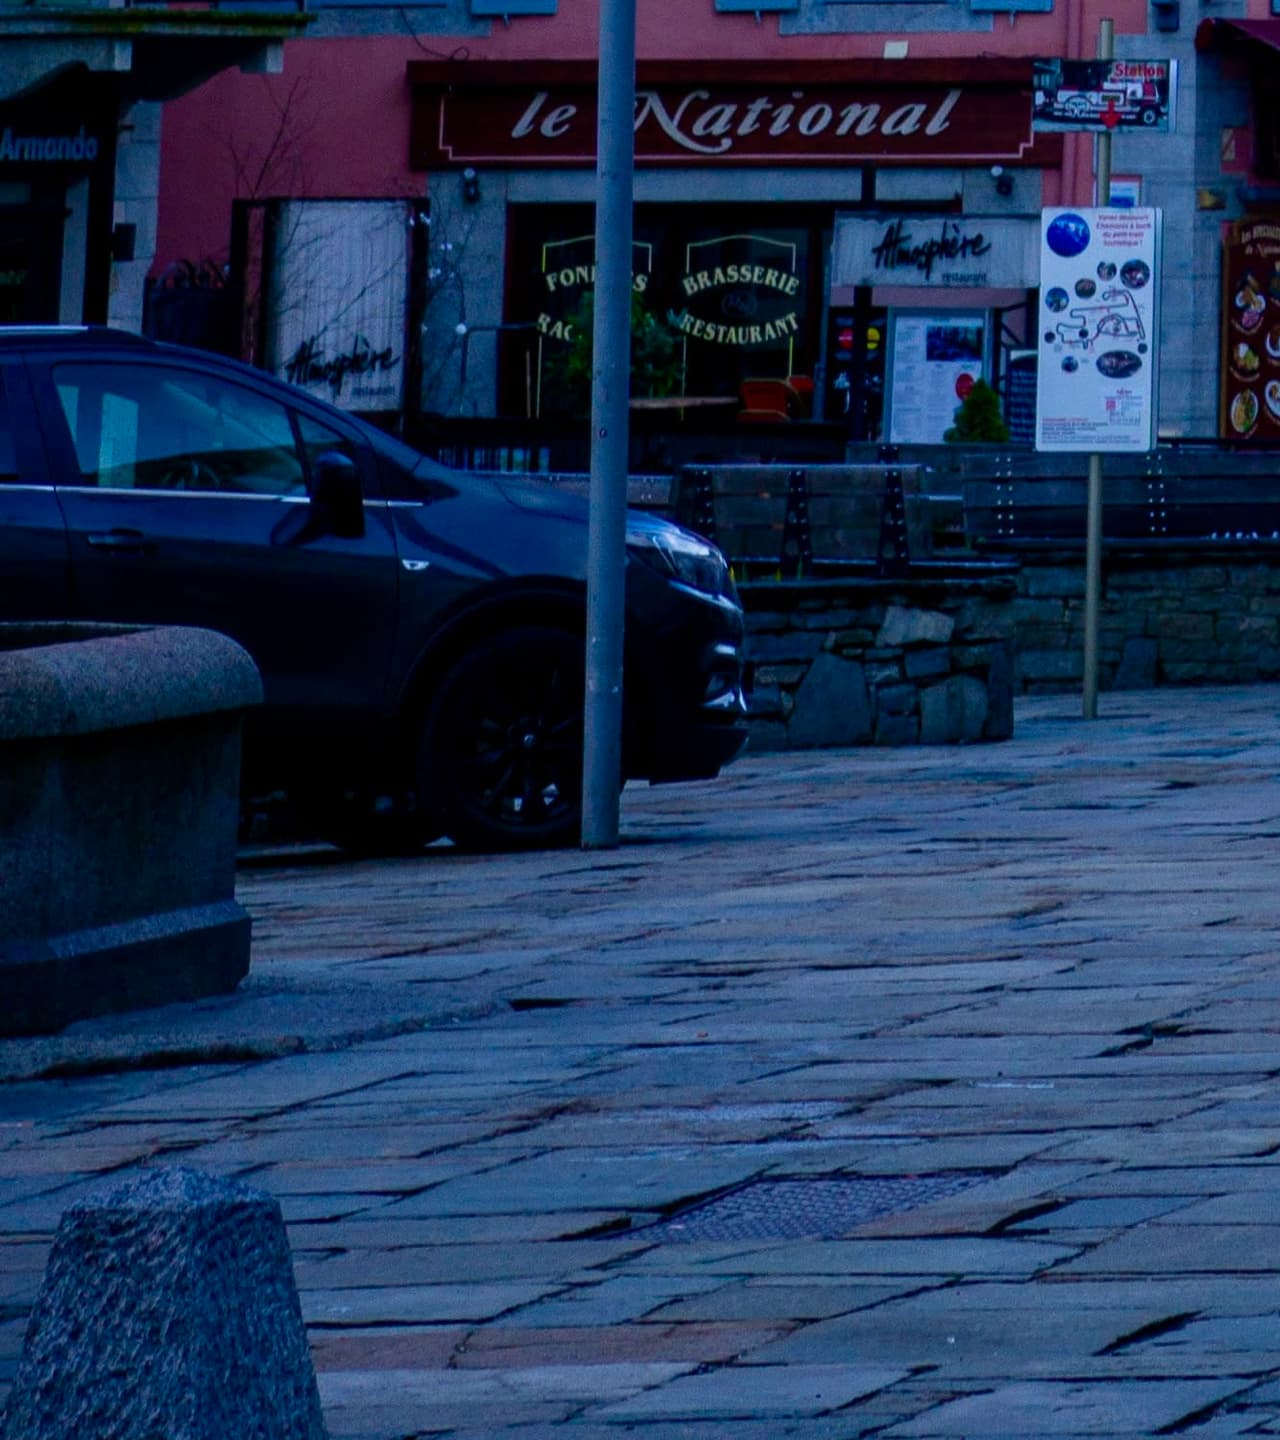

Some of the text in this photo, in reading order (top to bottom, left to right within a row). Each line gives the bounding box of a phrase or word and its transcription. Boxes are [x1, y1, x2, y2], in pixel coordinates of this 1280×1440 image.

[1115, 63, 1165, 77] Station
[510, 88, 962, 154] le National
[872, 218, 992, 280] Atmosphère
[545, 264, 648, 292] FONS
[682, 264, 800, 296] BRASSERIE
[680, 311, 799, 345] RESTAURANT
